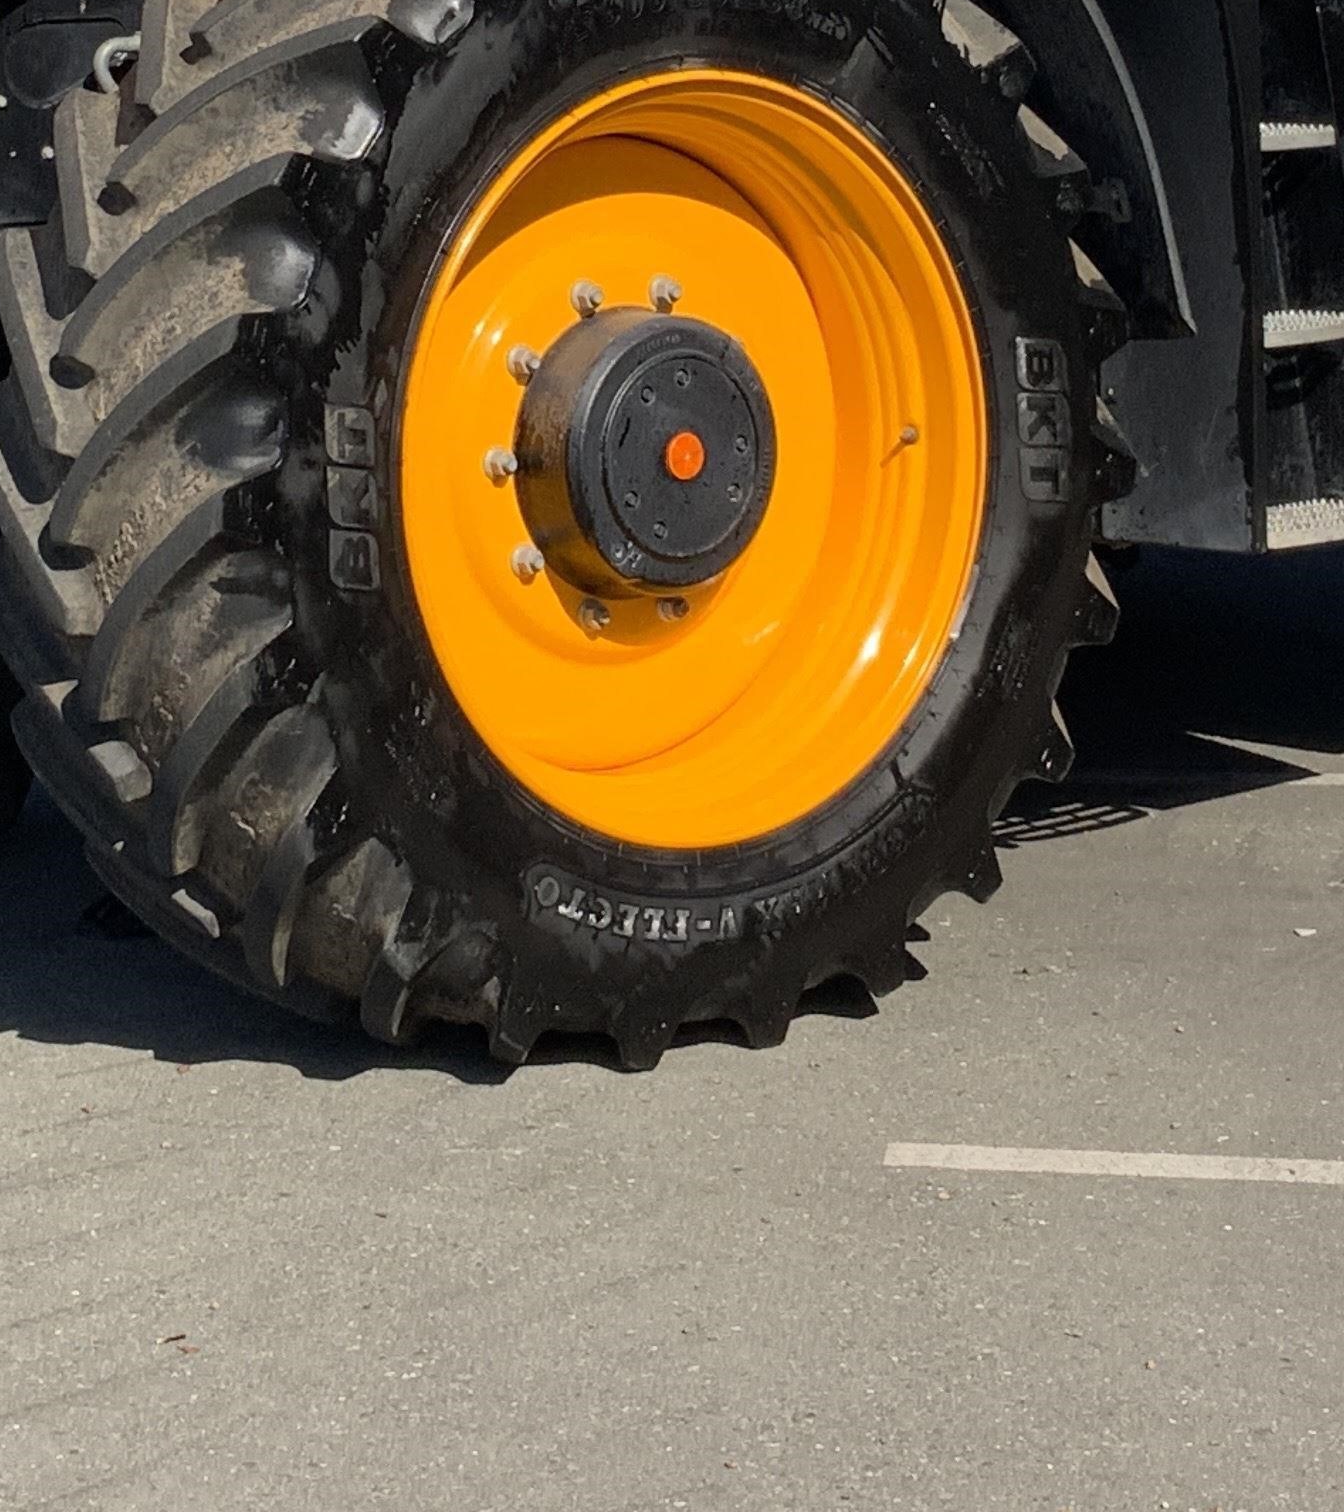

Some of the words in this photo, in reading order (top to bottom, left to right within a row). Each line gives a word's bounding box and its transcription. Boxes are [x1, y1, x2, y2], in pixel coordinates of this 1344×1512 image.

[328, 406, 378, 589] BKT
[1020, 338, 1066, 498] BKT
[535, 875, 738, 941] V-FLECTO
